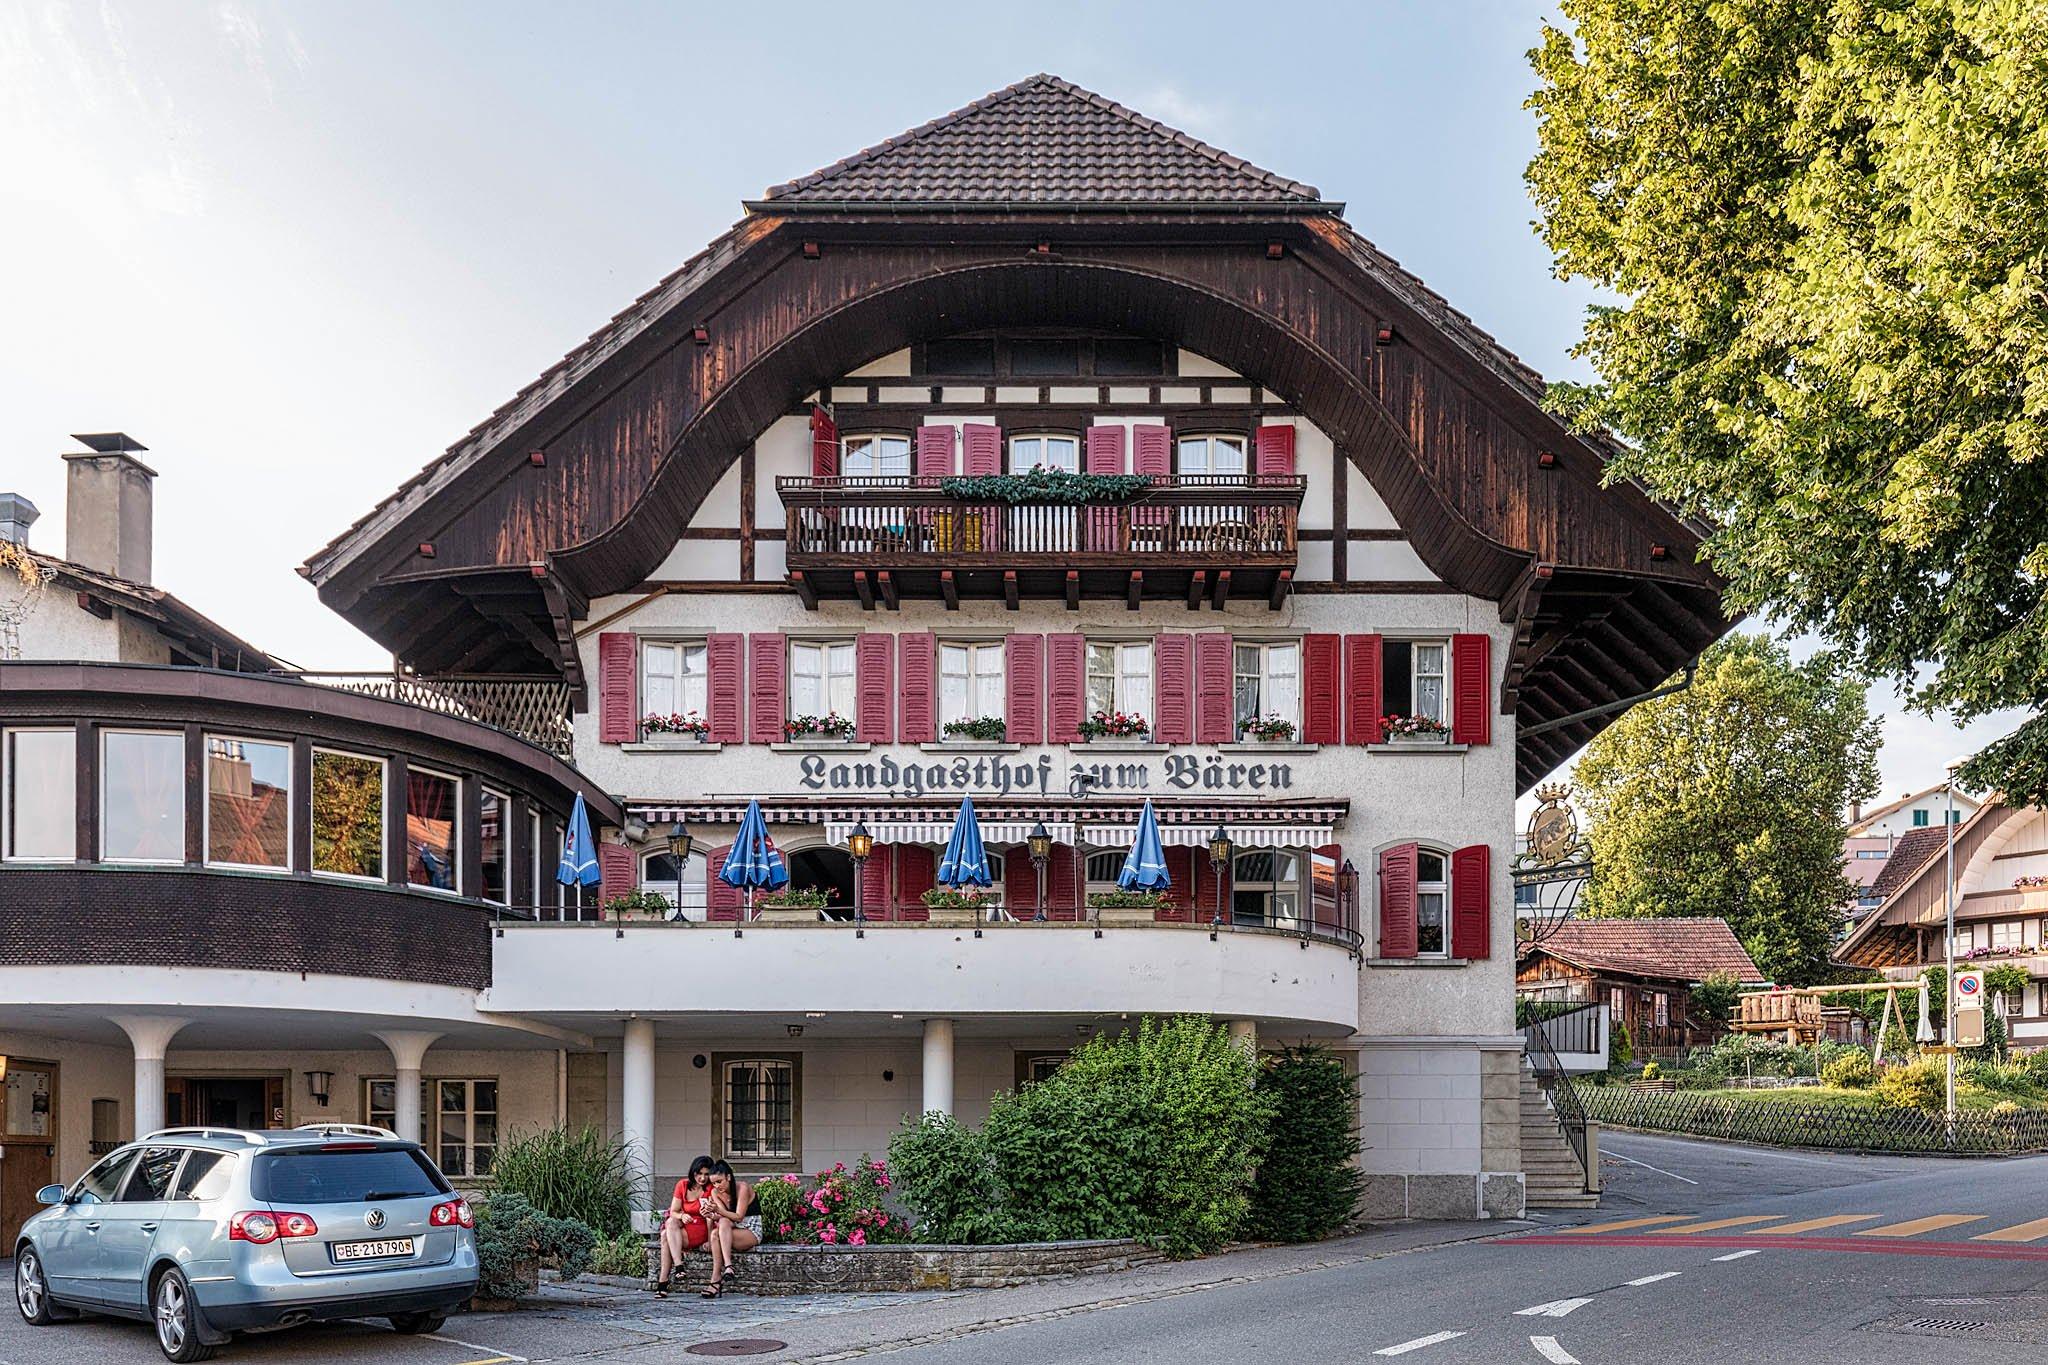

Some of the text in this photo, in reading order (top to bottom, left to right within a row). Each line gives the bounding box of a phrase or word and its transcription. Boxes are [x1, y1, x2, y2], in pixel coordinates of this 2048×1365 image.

[799, 754, 1294, 799] Landgasthof zum Bären
